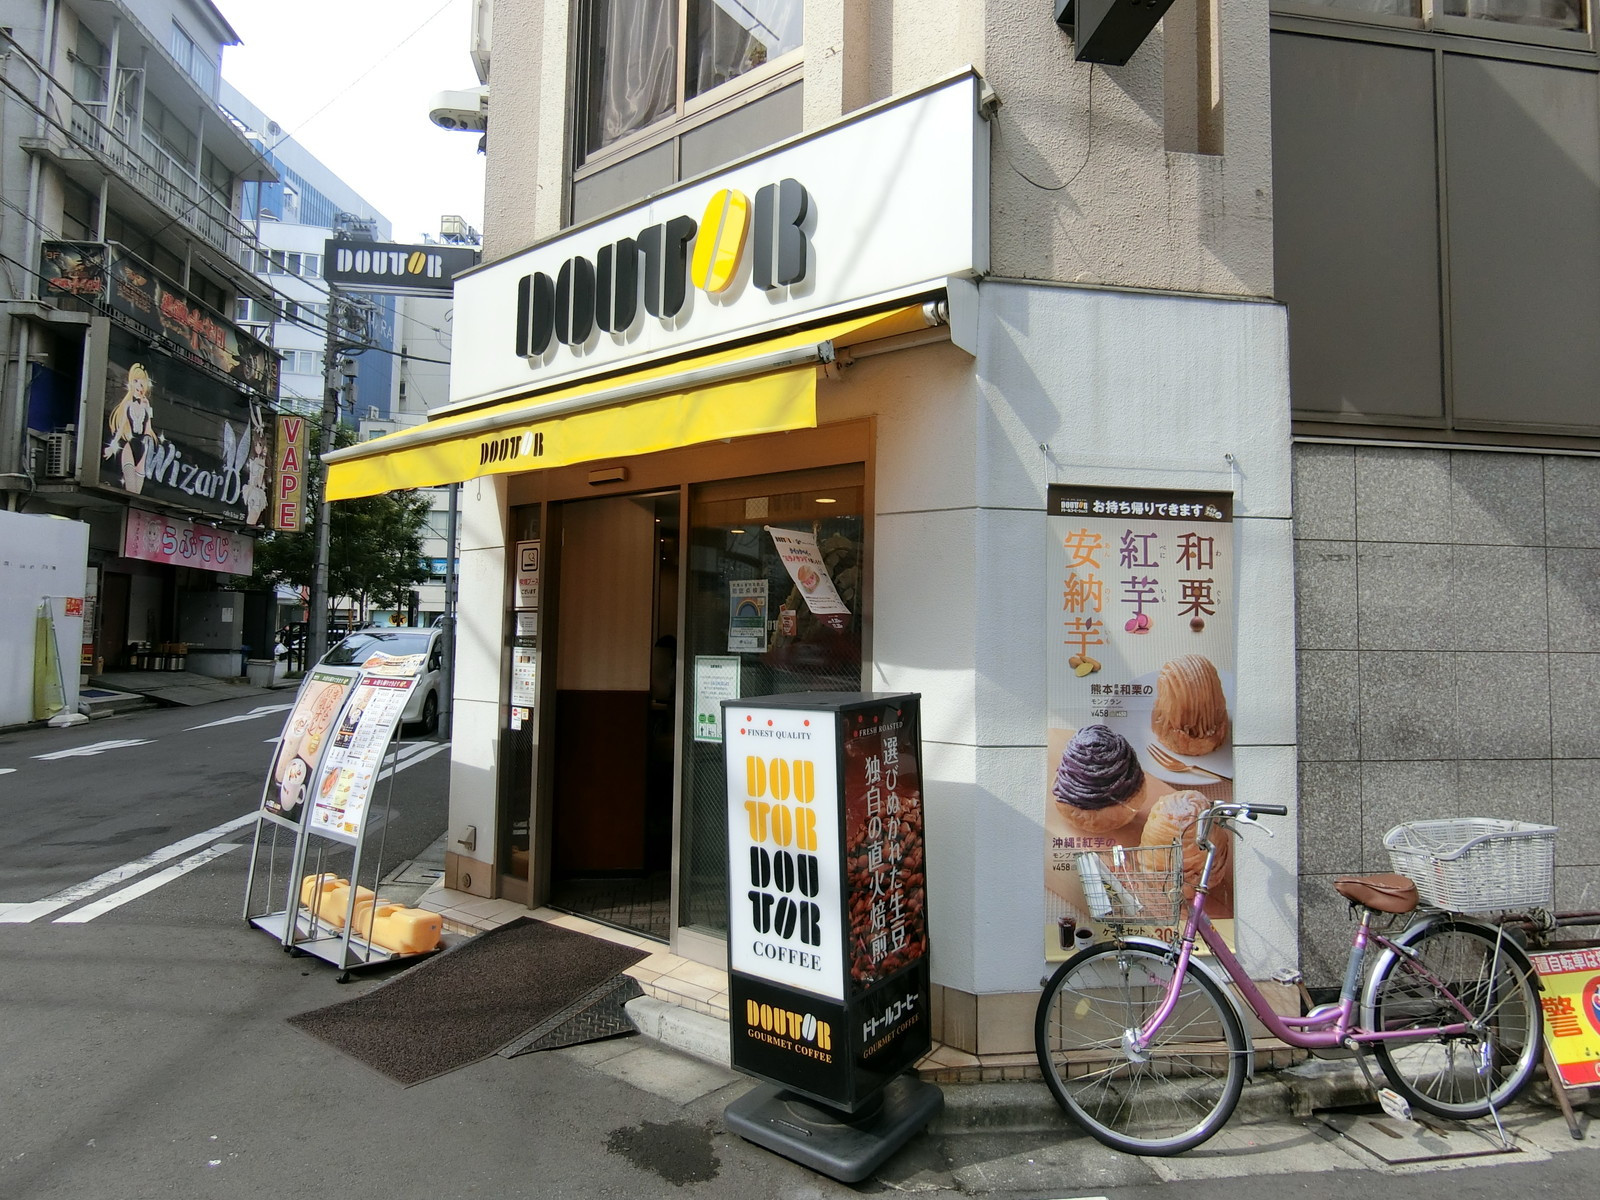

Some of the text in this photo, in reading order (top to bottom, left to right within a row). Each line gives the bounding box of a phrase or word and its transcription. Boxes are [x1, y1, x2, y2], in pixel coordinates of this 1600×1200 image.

[337, 248, 442, 279] DOUTOR
[516, 178, 809, 359] DOUTOR
[480, 431, 544, 466] DOUTOR
[279, 418, 301, 528] VAPE
[1092, 499, 1203, 518] お持ち帰りできます
[162, 526, 229, 563] らぶでじ
[1063, 528, 1104, 657] 安納芋
[1119, 529, 1160, 616] 紅芋
[1176, 532, 1216, 617] 和栗
[1091, 698, 1122, 706] モンブラン
[1091, 709, 1109, 717] ¥458
[747, 728, 811, 741] FINEST QUALITY
[859, 721, 904, 737] FRESH ROASTED
[746, 755, 815, 804] DOU
[744, 800, 818, 852] TOR
[882, 736, 907, 953] 選びぬかれた生豆
[749, 846, 820, 898] DOU
[864, 754, 888, 965] 独自の直火焙煎
[1052, 862, 1071, 871] ¥458
[747, 890, 822, 947] TOR
[752, 940, 822, 972] COFFEE
[1530, 951, 1600, 973] 置自転車は
[746, 999, 831, 1051] DOUTOR
[862, 993, 919, 1043] ドトールコーヒー
[863, 1013, 920, 1059] GOURMET COFFEE
[747, 1028, 833, 1064] GOURMET COFFEE
